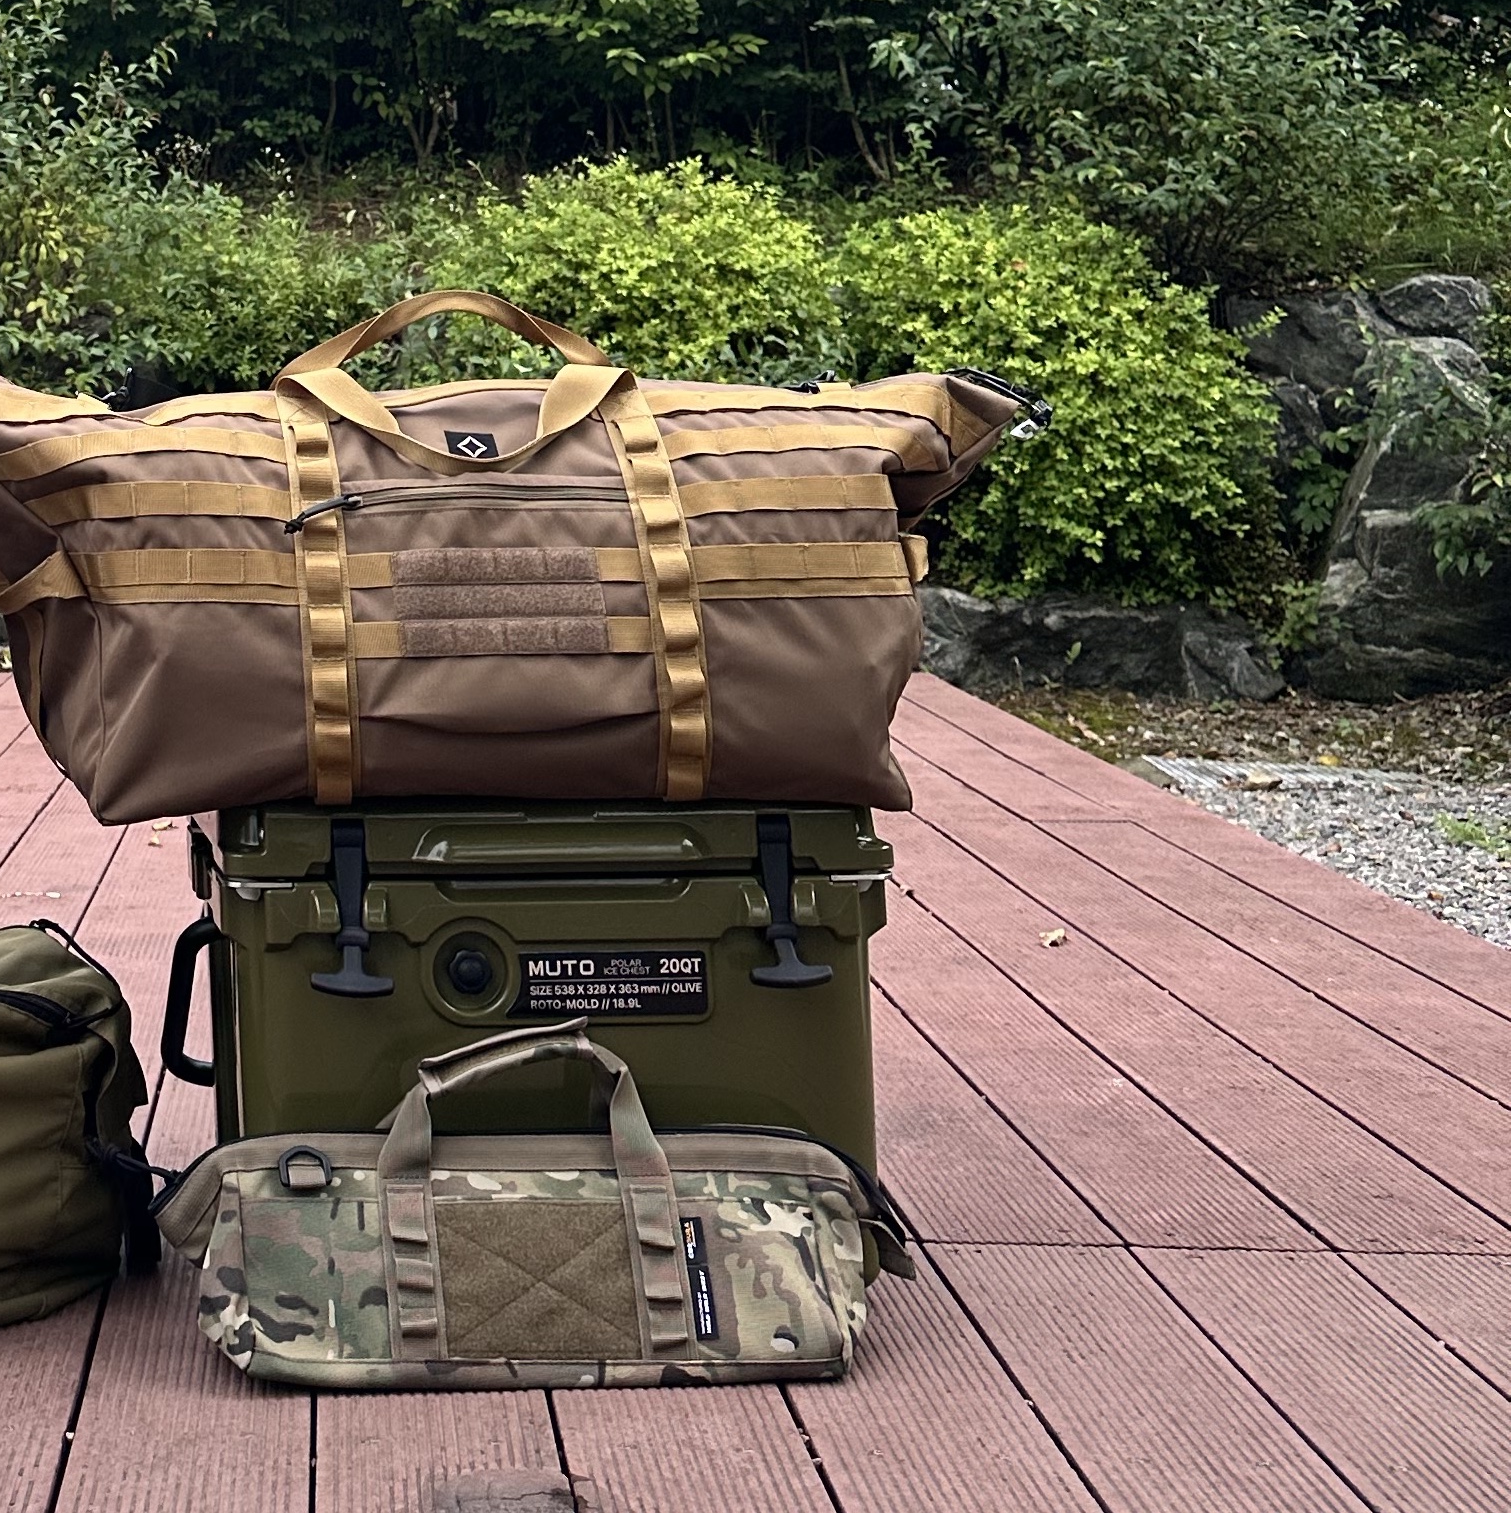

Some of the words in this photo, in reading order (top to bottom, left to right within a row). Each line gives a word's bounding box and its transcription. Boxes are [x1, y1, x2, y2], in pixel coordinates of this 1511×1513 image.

[528, 959, 595, 977] MUTO
[611, 958, 642, 968] POLAR
[659, 957, 702, 974] 20QT
[603, 967, 619, 976] ICE
[619, 966, 651, 975] CHEST
[529, 985, 553, 996] SIZE
[554, 984, 576, 996] 538
[586, 984, 607, 995] 328
[617, 983, 640, 994] 363
[640, 984, 661, 994] mm
[671, 982, 703, 993] OLIVE
[530, 998, 599, 1010] ROTO-MOLD
[612, 997, 642, 1009] 18.9L
